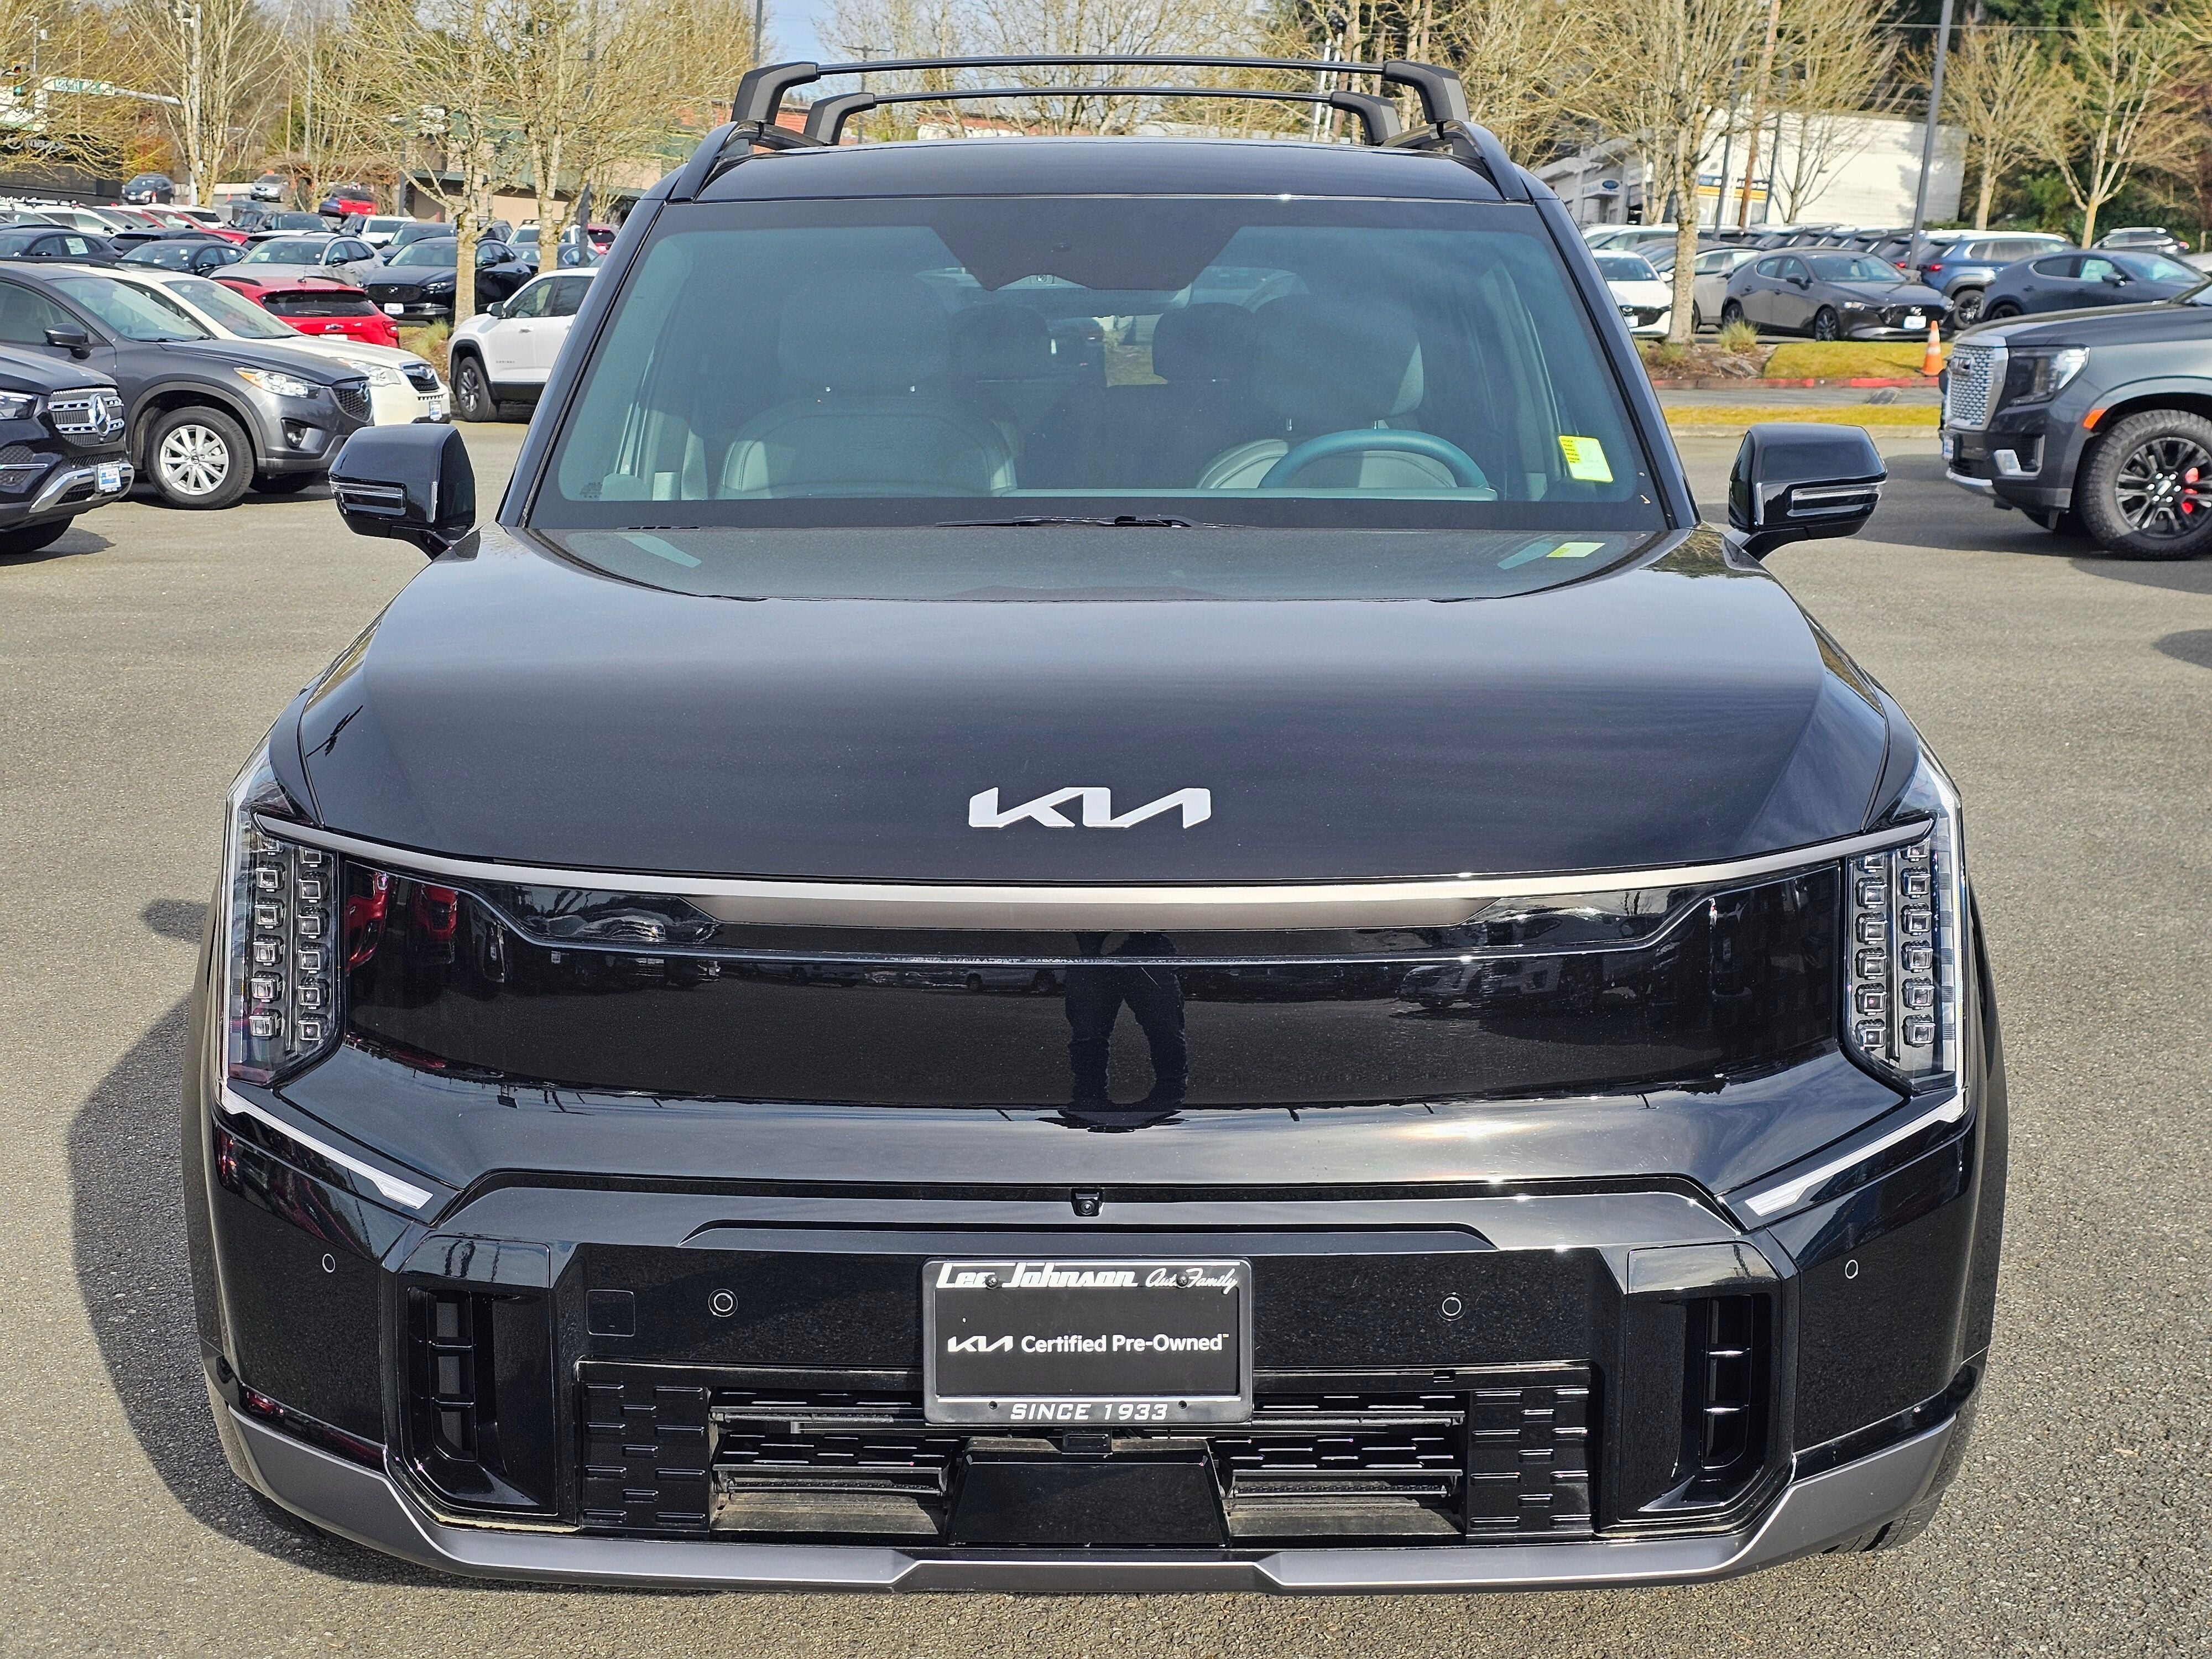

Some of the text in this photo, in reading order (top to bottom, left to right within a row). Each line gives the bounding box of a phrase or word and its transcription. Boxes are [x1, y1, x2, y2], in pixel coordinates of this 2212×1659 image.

[969, 787, 1211, 828] KIA
[1001, 1262, 1138, 1288] Johnson
[1145, 1268, 1182, 1288] Aut
[1186, 1268, 1238, 1295] Family
[948, 1335, 1014, 1352] KIA
[1021, 1335, 1106, 1353] Certified
[1010, 1404, 1168, 1420] SINCE 1933
